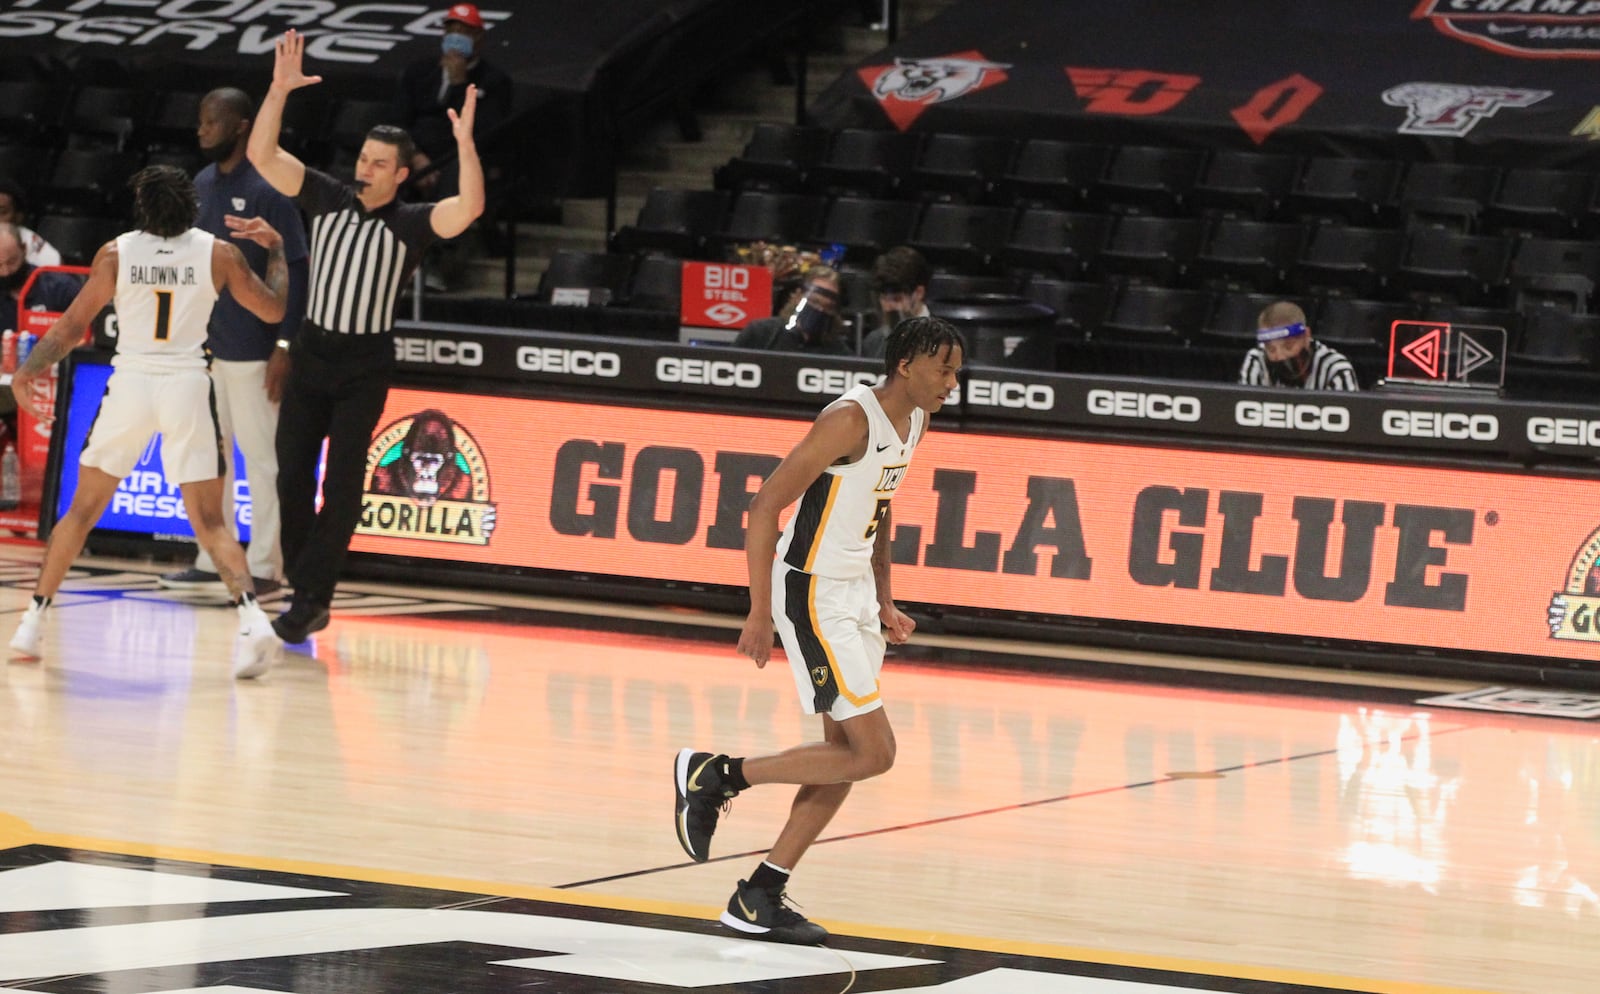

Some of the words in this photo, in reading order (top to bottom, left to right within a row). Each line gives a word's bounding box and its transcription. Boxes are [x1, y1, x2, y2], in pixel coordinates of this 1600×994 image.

[131, 265, 178, 285] BALDWIN
[181, 266, 198, 286] JR.
[705, 266, 749, 289] BIO
[705, 289, 748, 302] STEEL
[154, 289, 174, 342] 1
[516, 346, 621, 378] GEICO
[656, 357, 762, 388] GEICO
[797, 367, 886, 395] GEIC
[1087, 388, 1201, 422] GEICO
[1235, 400, 1350, 432] GEICO
[1382, 409, 1499, 441] GEICO
[874, 465, 907, 491] VCU
[361, 501, 474, 537] GORILLA
[549, 438, 1092, 580] GORLA
[1128, 484, 1475, 611] GLUE
